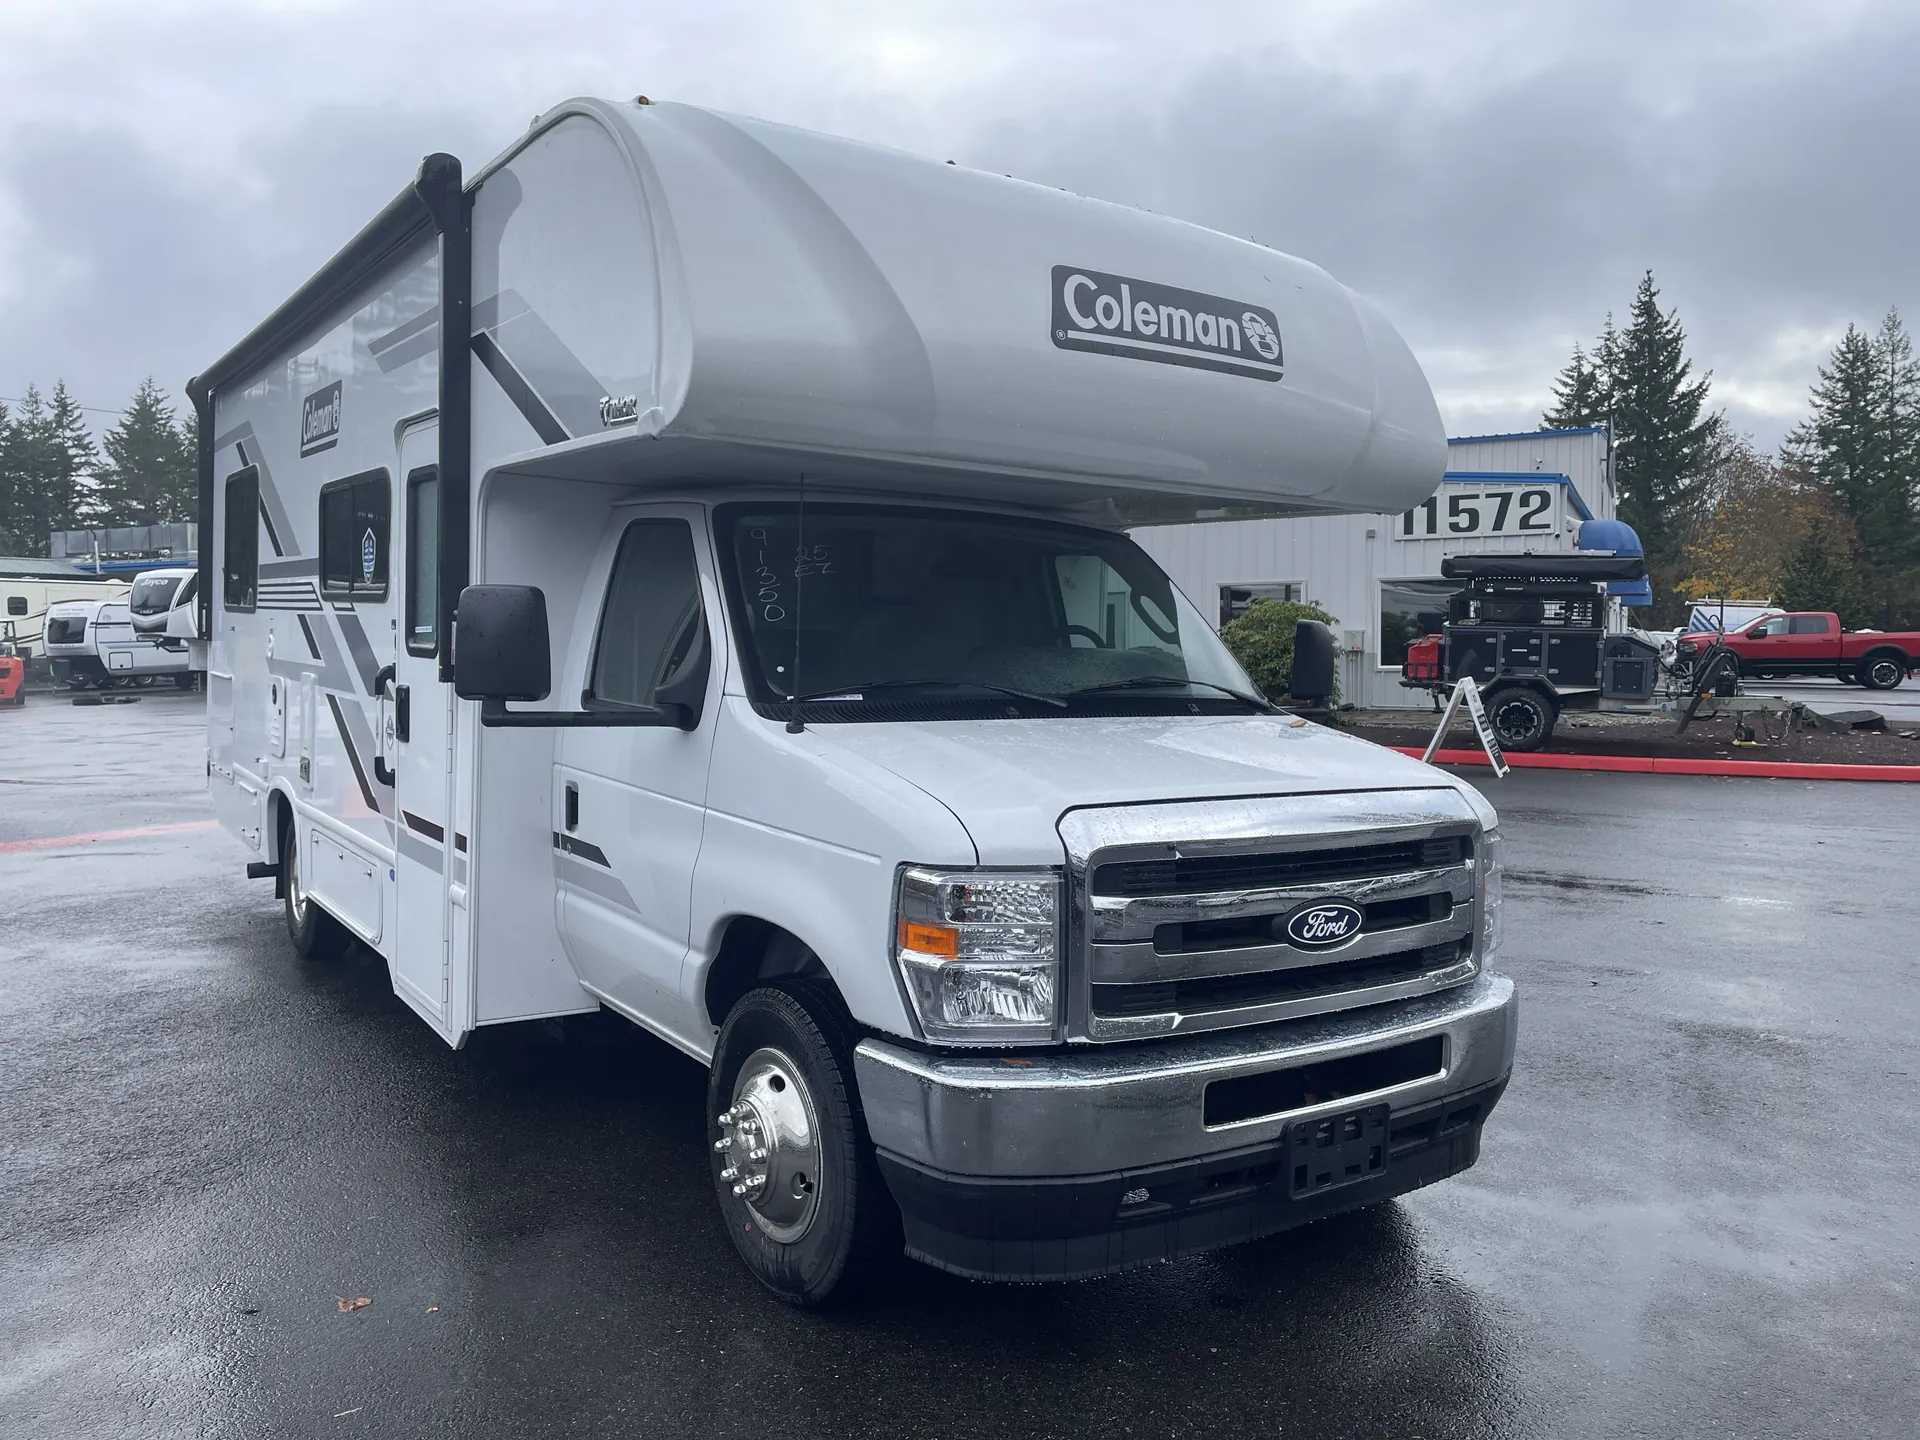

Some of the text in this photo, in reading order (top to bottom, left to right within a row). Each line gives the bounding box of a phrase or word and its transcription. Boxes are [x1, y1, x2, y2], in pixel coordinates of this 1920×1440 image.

[1063, 274, 1242, 351] Coleman
[303, 400, 333, 443] Coleman
[1403, 490, 1551, 535] 11572
[141, 578, 168, 587] Jayco
[1303, 910, 1349, 938] Ford
